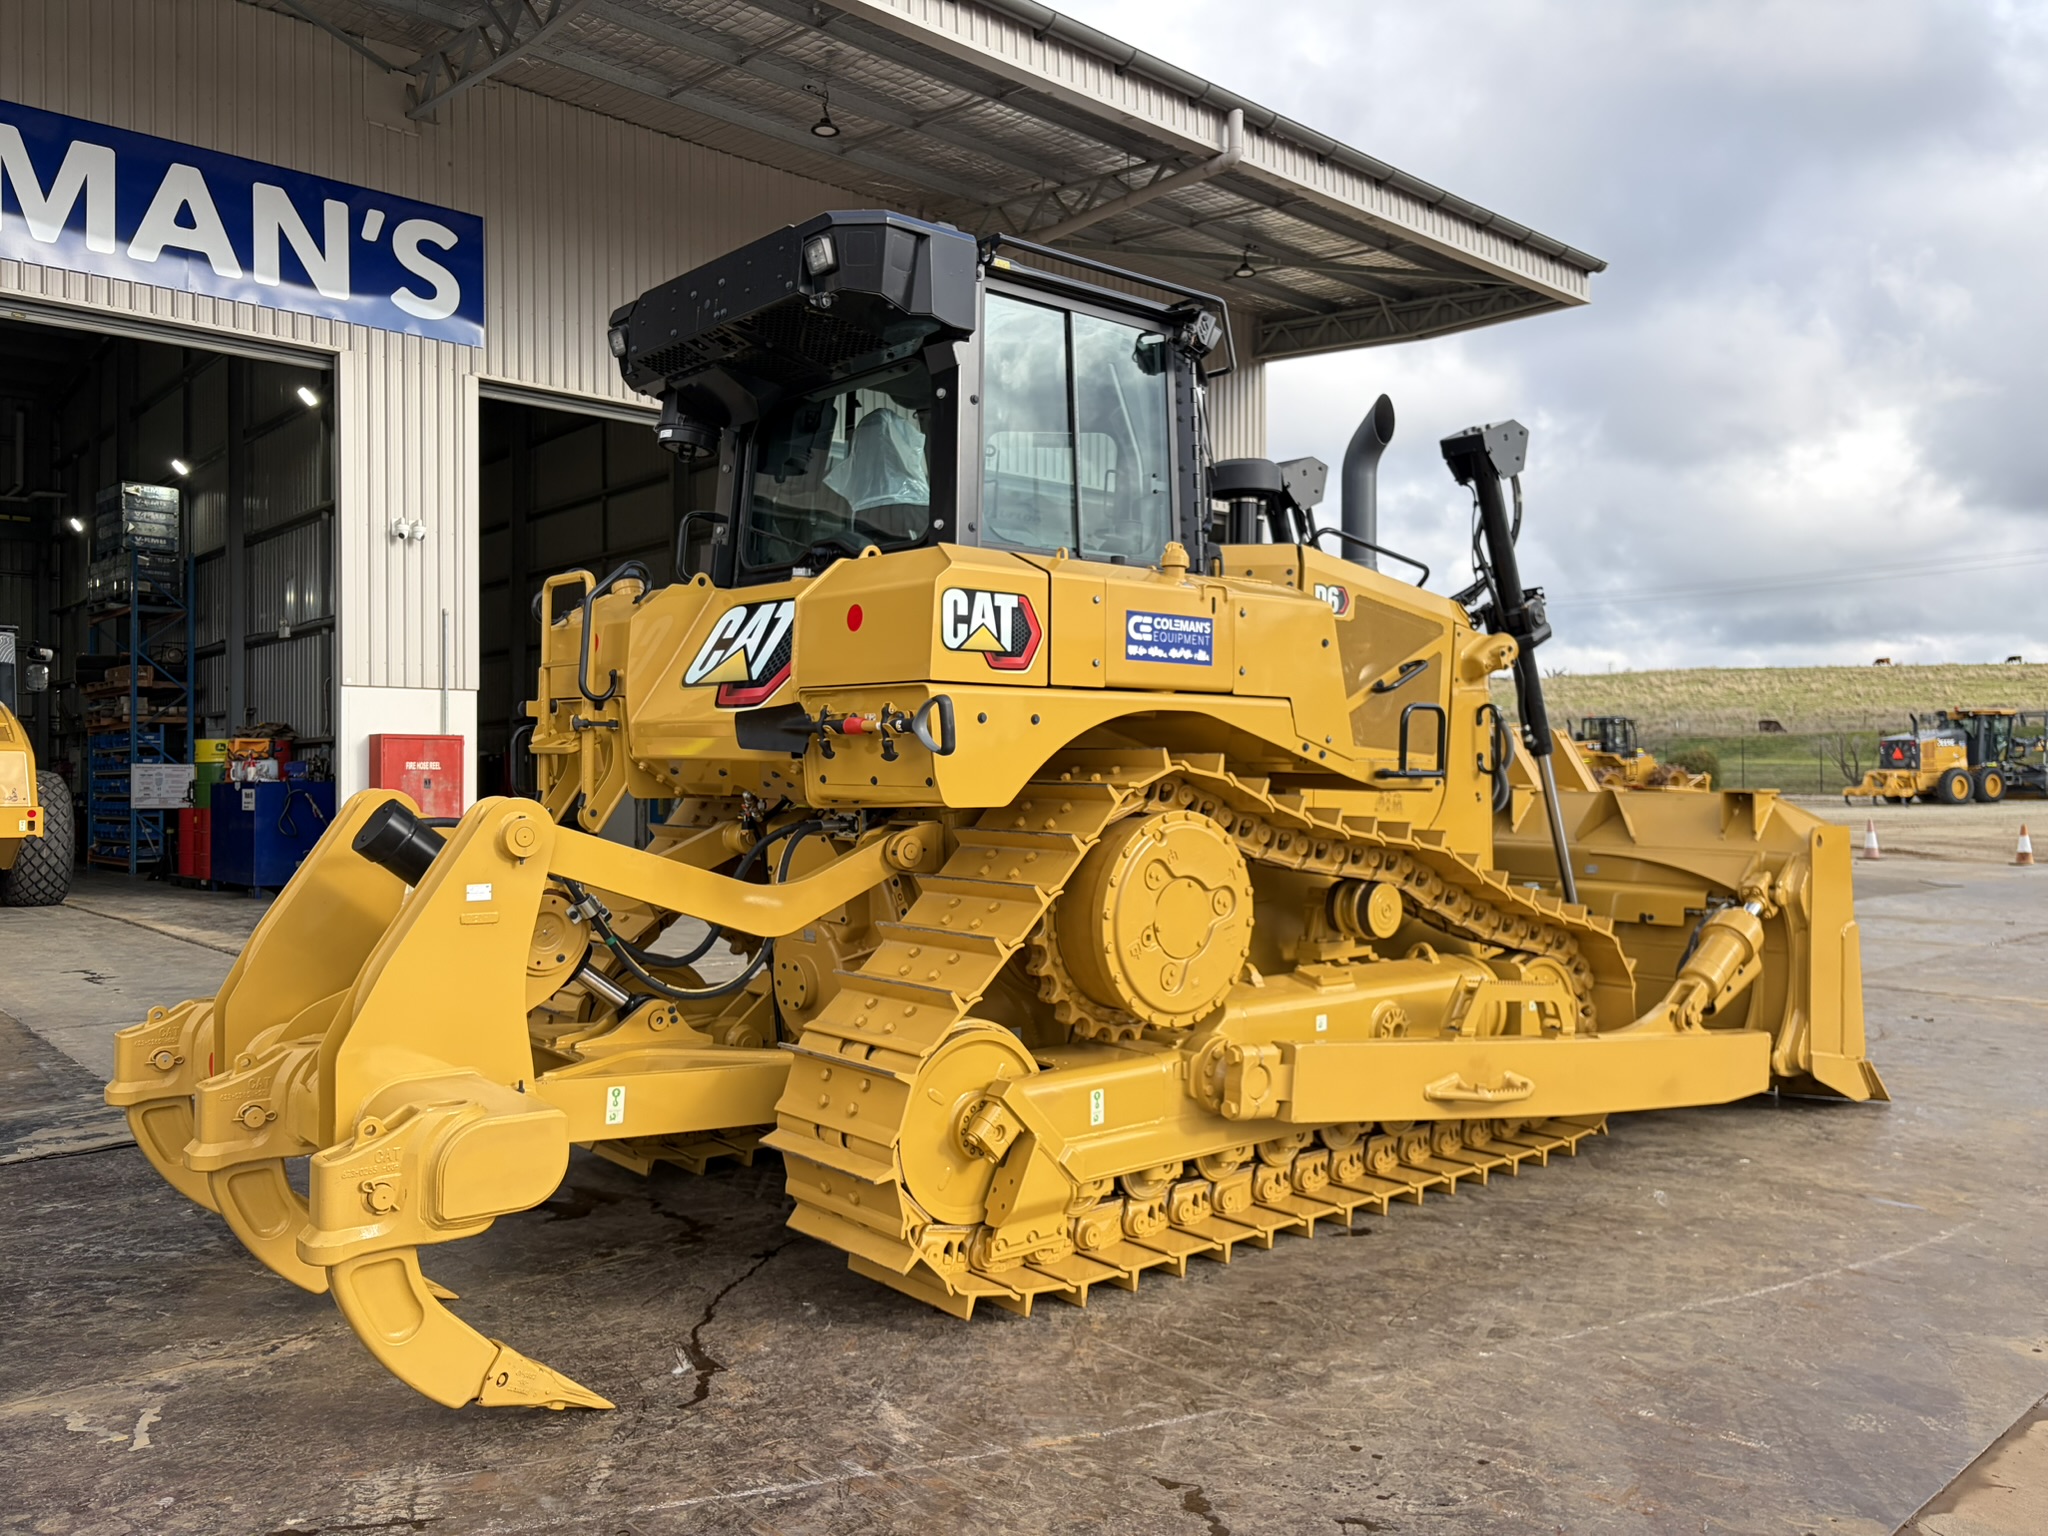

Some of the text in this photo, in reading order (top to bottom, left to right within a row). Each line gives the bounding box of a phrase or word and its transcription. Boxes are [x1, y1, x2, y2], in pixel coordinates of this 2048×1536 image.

[942, 588, 1019, 652] CAT
[1153, 617, 1211, 634] COLEMAN'S
[685, 600, 796, 684] CAT
[1153, 630, 1210, 646] EQUIPMENT
[406, 761, 441, 770] FIRE HOSE REEL
[248, 1076, 271, 1089] CAT
[374, 1146, 401, 1164] CAT
